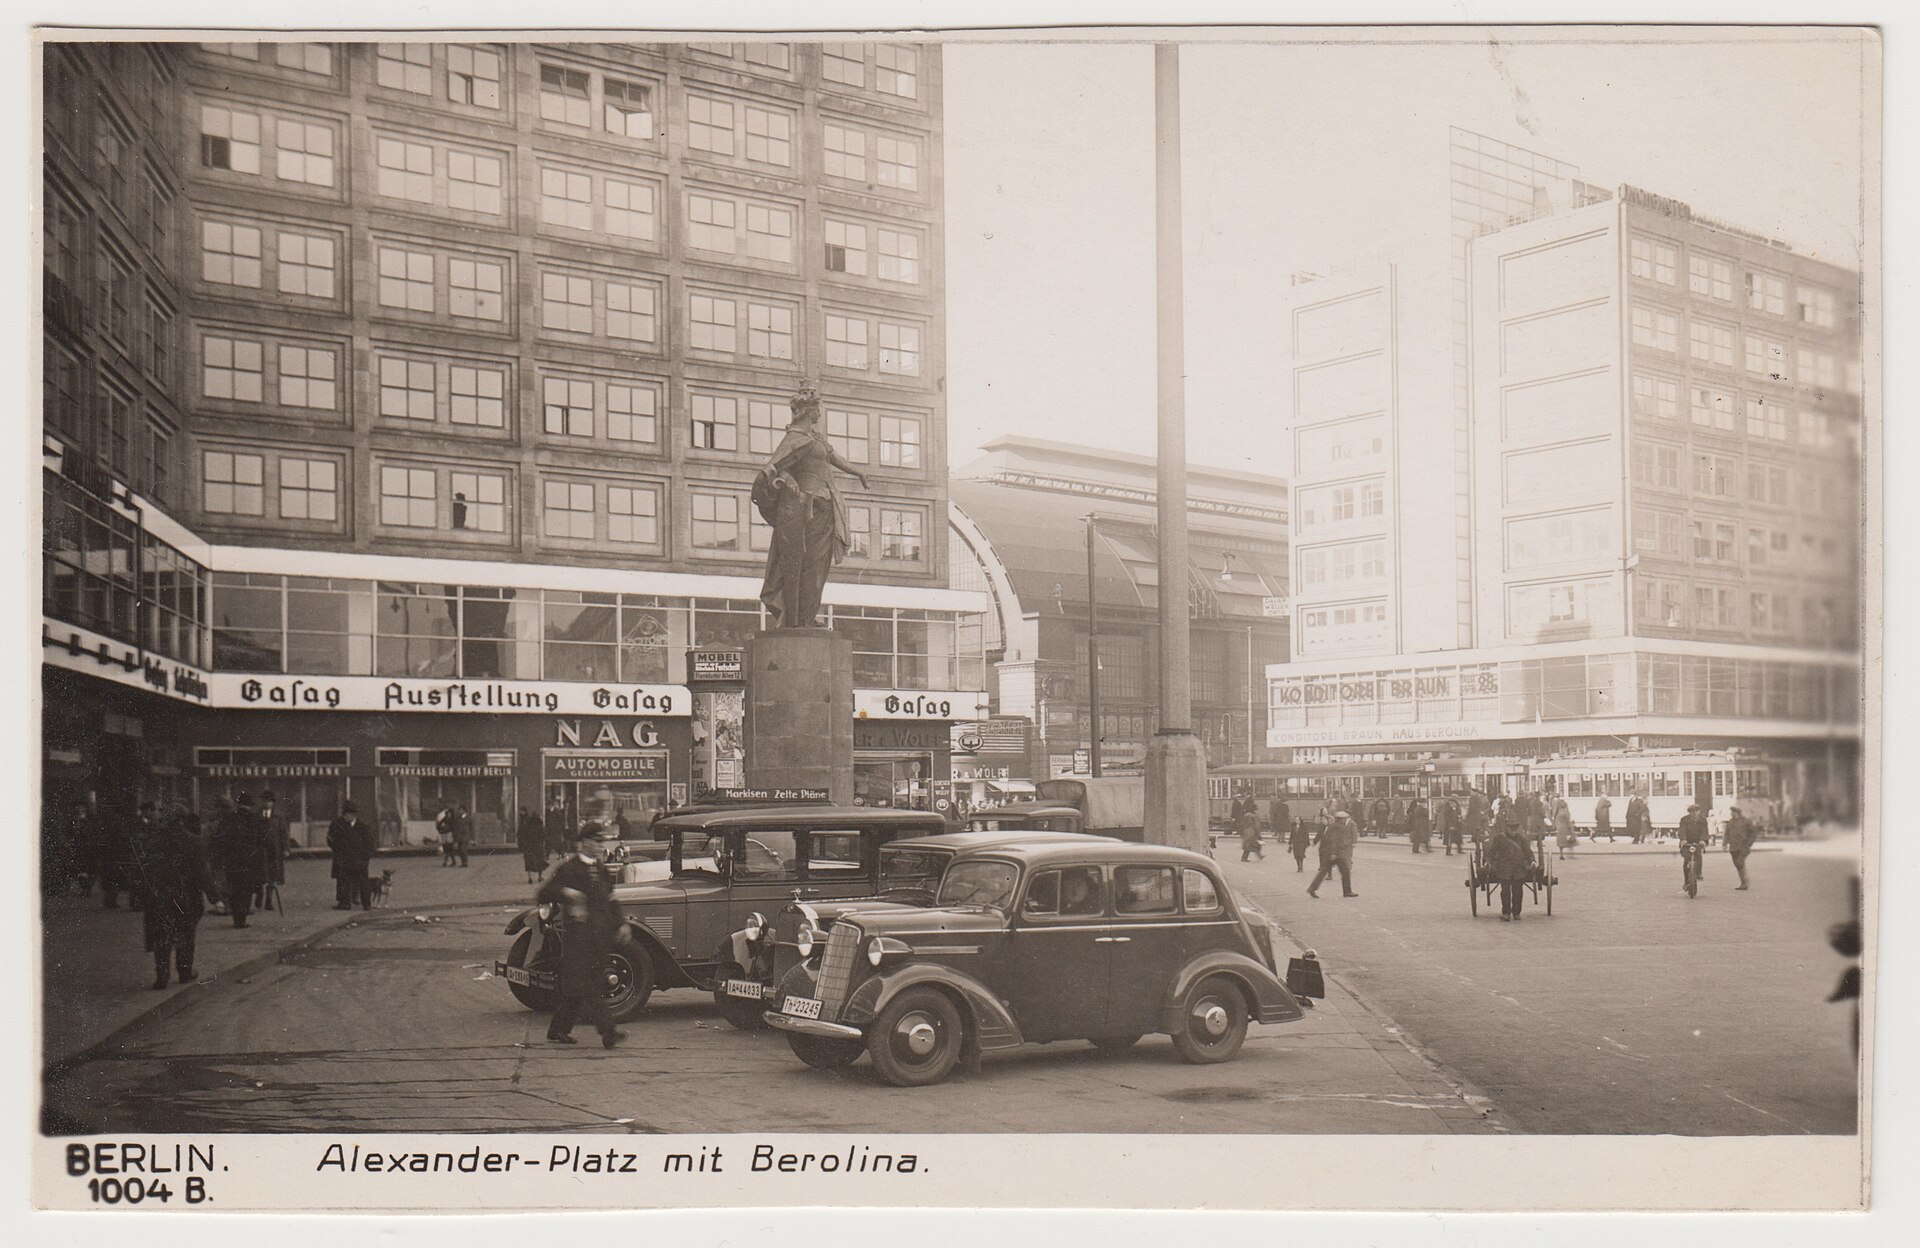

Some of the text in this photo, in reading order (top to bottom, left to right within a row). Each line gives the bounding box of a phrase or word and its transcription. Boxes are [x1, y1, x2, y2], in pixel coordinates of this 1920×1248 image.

[555, 758, 655, 770] AUTOMOBILE
[389, 766, 512, 777] SPARKASSE DER STADT BERLIN
[570, 770, 643, 778] GELEGENHEITEN
[725, 789, 768, 799] Markisen
[774, 789, 798, 799] Zelte
